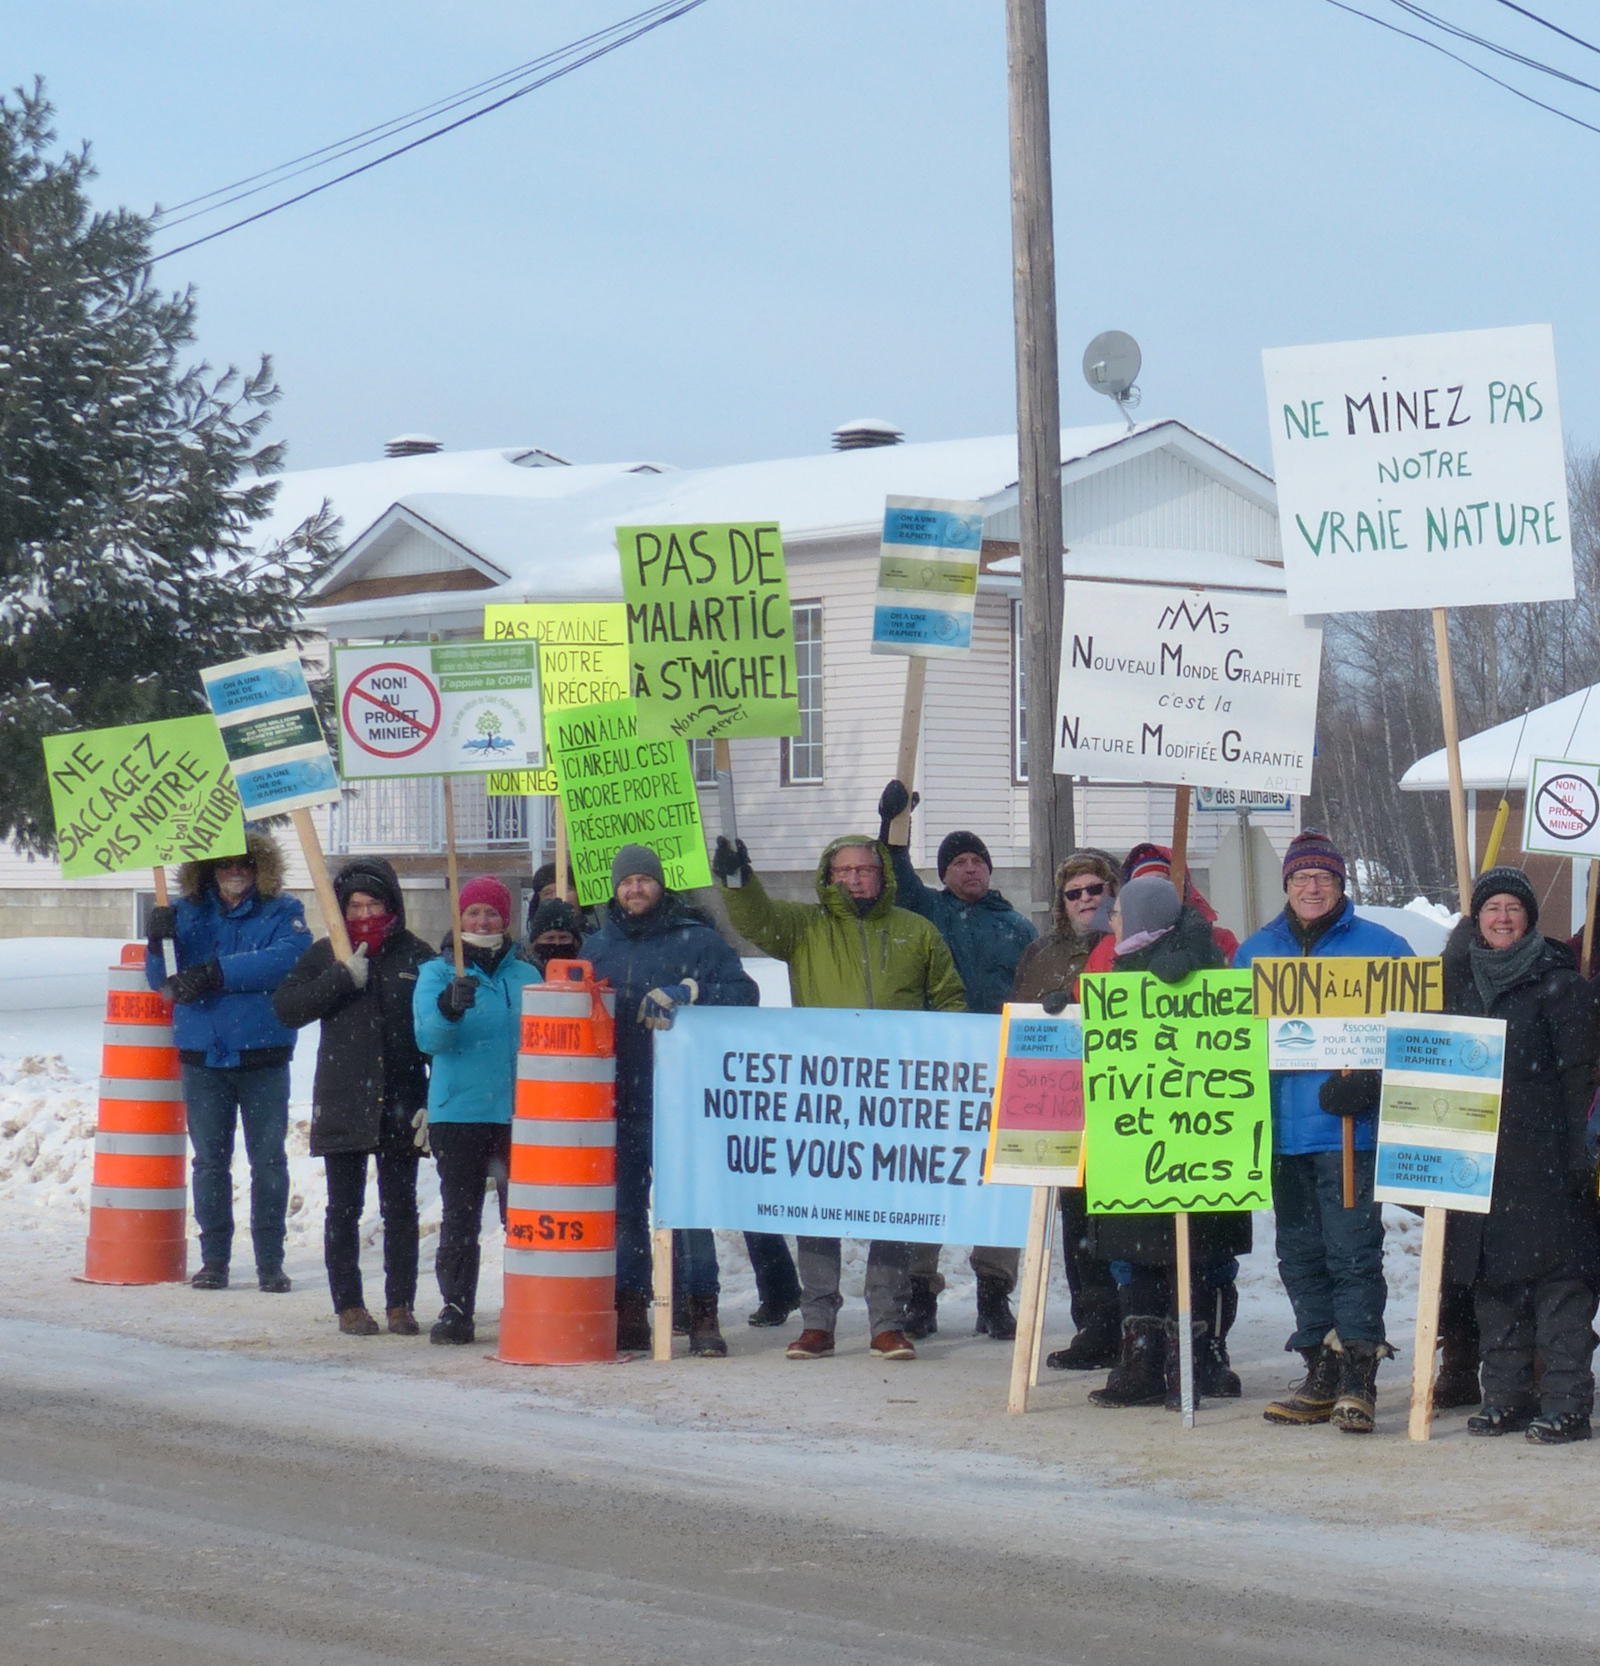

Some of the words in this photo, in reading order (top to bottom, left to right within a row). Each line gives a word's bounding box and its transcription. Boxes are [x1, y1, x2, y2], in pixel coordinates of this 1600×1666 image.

[1284, 400, 1329, 440] NE
[1345, 376, 1471, 435] MINEZ
[1488, 381, 1543, 424] PAS
[1378, 448, 1472, 484] NOTRE
[1295, 498, 1408, 557] VRAIE
[1426, 500, 1562, 552] NATURE
[636, 530, 717, 586] PAS
[729, 527, 781, 585] DE
[495, 621, 529, 638] PAS
[537, 621, 555, 641] DE
[558, 618, 608, 641] MINE
[626, 590, 785, 644] MALARTIC
[545, 651, 603, 672] NOTRE
[371, 677, 407, 690] NON!
[634, 663, 651, 698] À
[380, 694, 400, 706] AU
[1214, 696, 1232, 713] la
[365, 710, 419, 724] PROJET
[369, 727, 421, 740] MINIER
[558, 720, 597, 748] NON
[52, 742, 104, 794] NE
[636, 741, 675, 768] C'EST
[58, 733, 170, 862] SACCAGEZ
[490, 771, 558, 792] NON-NEG
[567, 782, 621, 812] ENCORE
[624, 772, 682, 801] PROPRE
[1216, 790, 1235, 804] des
[1555, 781, 1576, 790] NON
[94, 824, 141, 872] PAS
[130, 751, 209, 835] NOTRE
[179, 763, 239, 860] NATURE
[1561, 794, 1574, 804] AU
[572, 809, 655, 843] PRÉSERVONS
[658, 801, 698, 828] CETTE
[1550, 820, 1584, 831] MINIER
[581, 877, 612, 901] NOT
[1083, 977, 1128, 1020] Ne
[1141, 976, 1253, 1019] touchez
[1253, 962, 1322, 1016] NON
[1324, 970, 1338, 998] À
[1343, 979, 1363, 997] LA
[1364, 957, 1441, 1015] MINE
[1323, 1036, 1347, 1044] POUR
[1350, 1036, 1360, 1044] LA
[1342, 1023, 1385, 1032] ASSOCIATI
[1084, 1028, 1138, 1064] pas
[1154, 1024, 1179, 1051] à
[1196, 1027, 1252, 1051] nos
[1324, 1047, 1337, 1055] DU
[1341, 1047, 1357, 1055] LAC
[723, 1052, 793, 1085] C'EST
[800, 1055, 890, 1089] NOTRE
[1089, 1056, 1255, 1102] rivières
[704, 1088, 787, 1122] NOTRE
[795, 1093, 849, 1129] AIR,
[858, 1096, 950, 1130] NOTRE
[959, 1100, 993, 1133] EA
[1114, 1107, 1154, 1136] et
[1169, 1110, 1234, 1135] nos
[727, 1134, 777, 1175] QUE
[786, 1138, 865, 1180] VOUS
[872, 1143, 972, 1186] MINEZ
[1145, 1140, 1234, 1184] lacs
[787, 1205, 808, 1218] NON
[811, 1205, 819, 1219] À
[821, 1207, 842, 1221] UNE
[845, 1209, 870, 1222] MINE
[873, 1211, 887, 1223] DE
